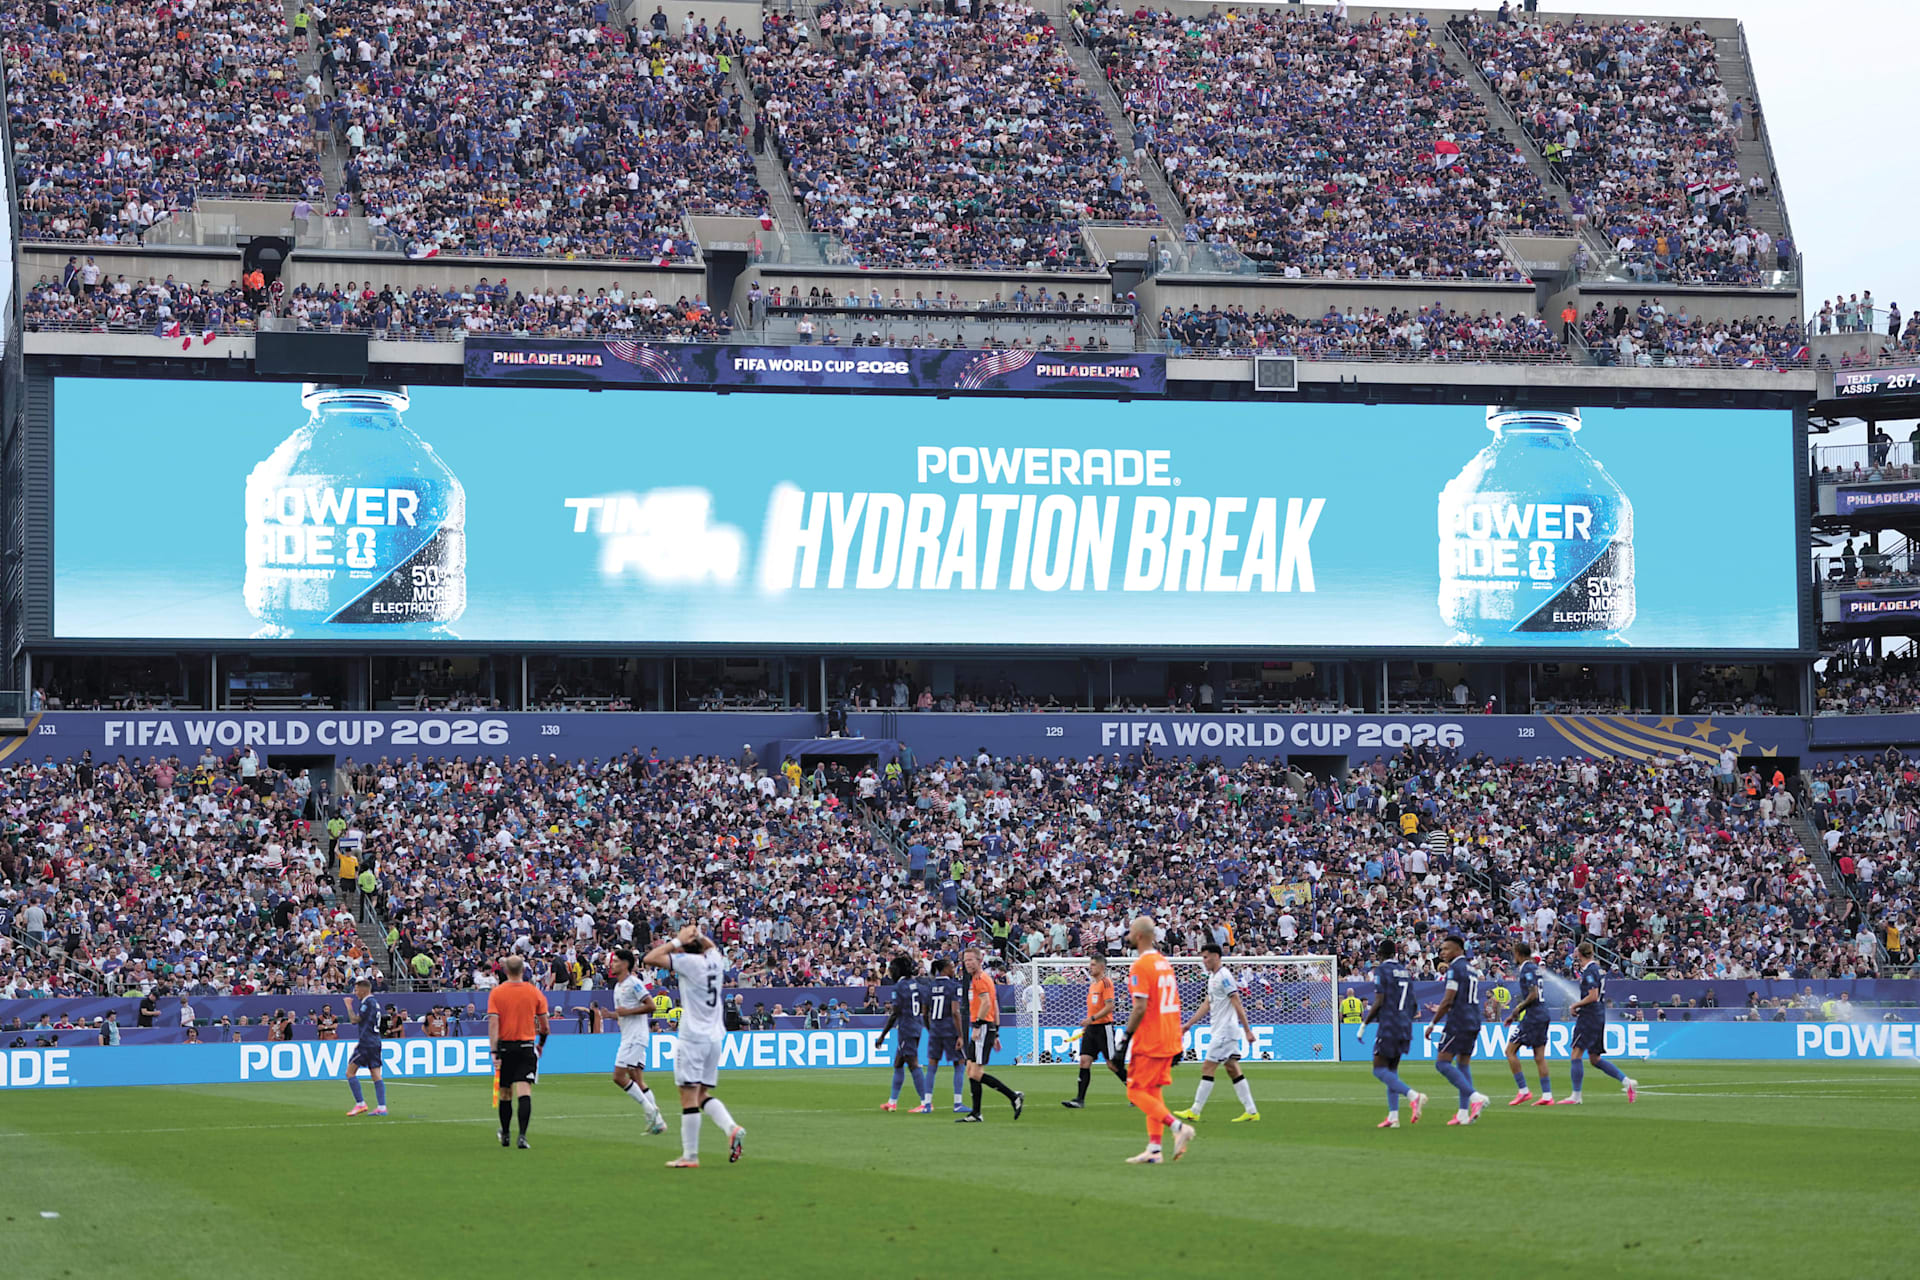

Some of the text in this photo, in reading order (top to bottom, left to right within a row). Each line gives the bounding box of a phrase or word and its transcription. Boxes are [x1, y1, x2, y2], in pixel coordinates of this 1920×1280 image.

[493, 352, 603, 366] PHILADELPHIA
[734, 358, 910, 374] FIFA WORLD CUP 2026
[1036, 364, 1140, 378] PHILADELPHIA
[1846, 374, 1872, 384] TEXT
[1842, 384, 1879, 394] ASSIST
[766, 490, 1120, 592] HYDRATION
[1123, 494, 1326, 594] BREAK
[1850, 600, 1920, 613] PHILADELP
[38, 724, 57, 735] 131
[104, 719, 509, 746] FIFA WORLD CUP 2026
[541, 724, 560, 735] 130
[1046, 726, 1064, 737] 129
[1101, 722, 1464, 748] FIFA WORLD CUP 2026
[1518, 727, 1535, 738] 128
[706, 975, 717, 1008] 5
[1157, 974, 1180, 1014] 22
[1398, 981, 1409, 1011] 7
[911, 992, 920, 1016] 6
[931, 995, 945, 1020] 11
[651, 1030, 891, 1069] PWERADE
[1796, 1023, 1920, 1057] POWE
